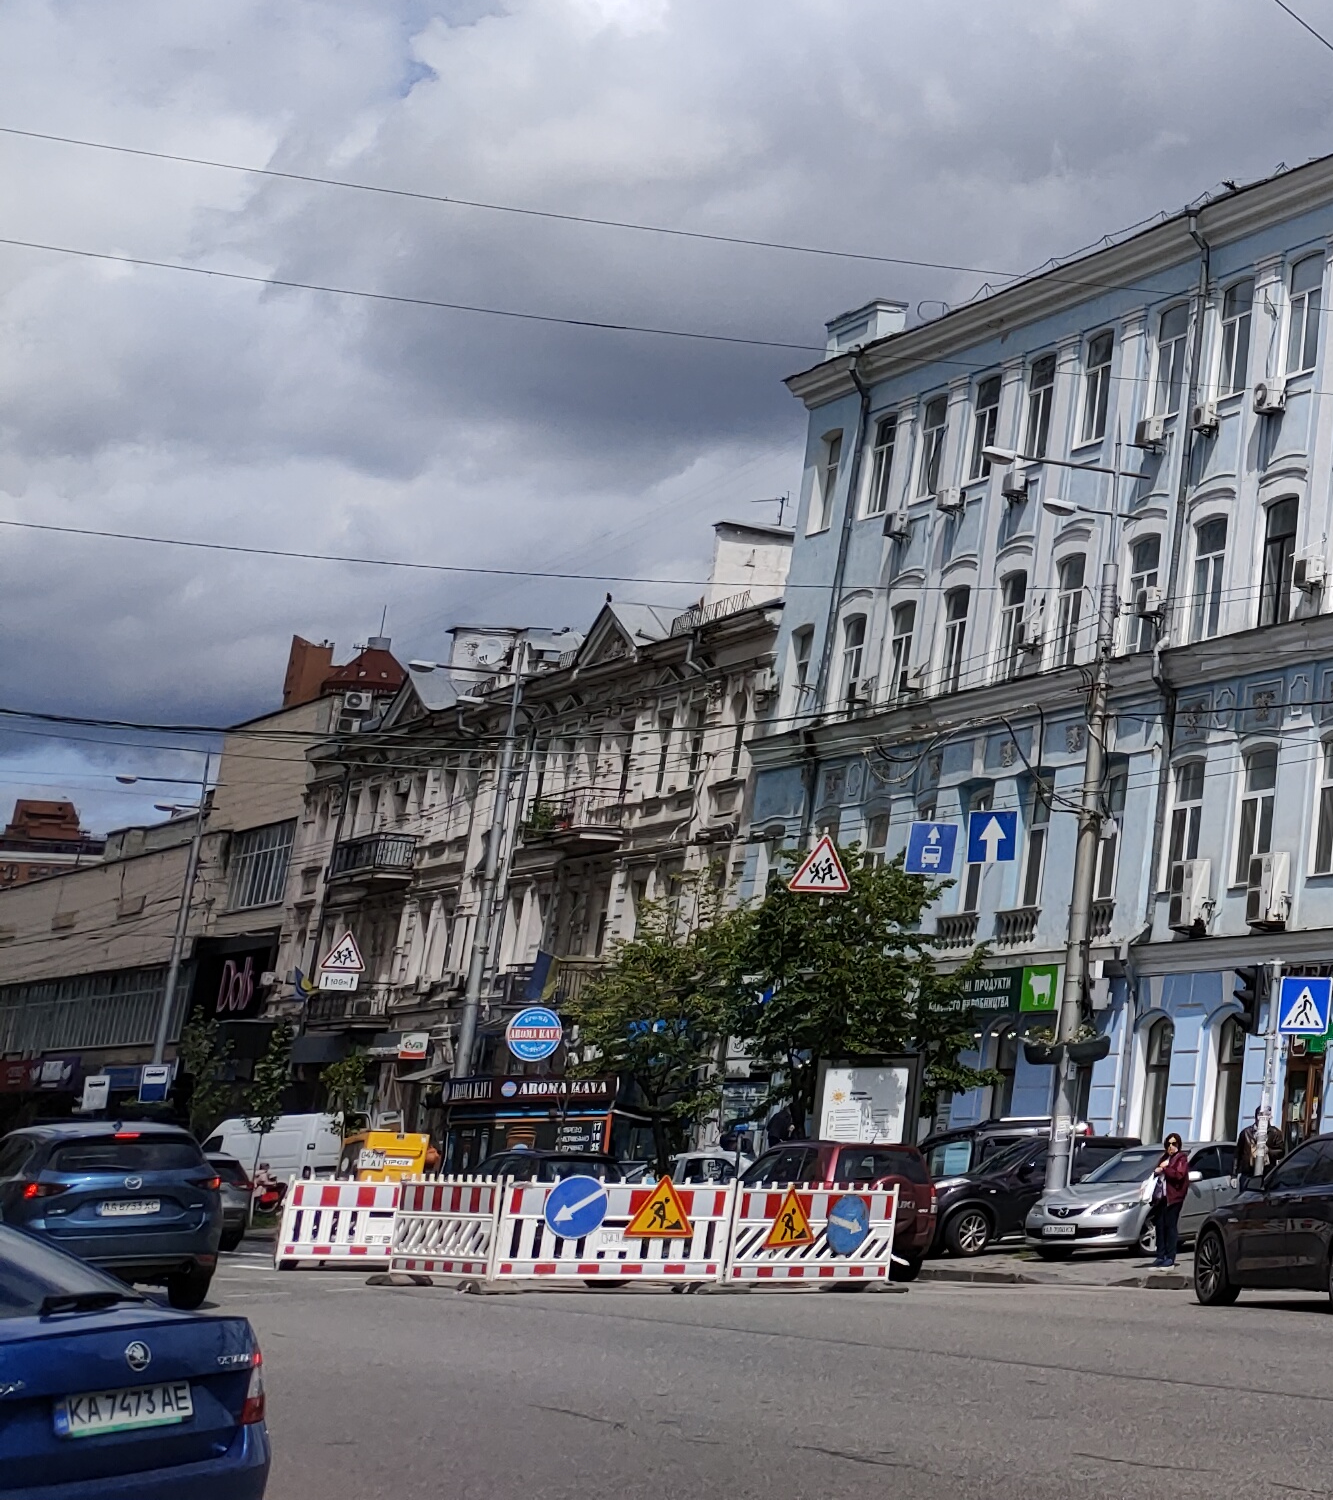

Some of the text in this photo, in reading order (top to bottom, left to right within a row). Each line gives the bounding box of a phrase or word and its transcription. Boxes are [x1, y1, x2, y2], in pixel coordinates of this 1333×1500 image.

[974, 976, 1011, 992] ПРОДУКТИ
[510, 1028, 560, 1039] AROMA KAVA
[518, 1081, 607, 1096] AROMA KAVA
[70, 1385, 190, 1425] KA 7473 AE
